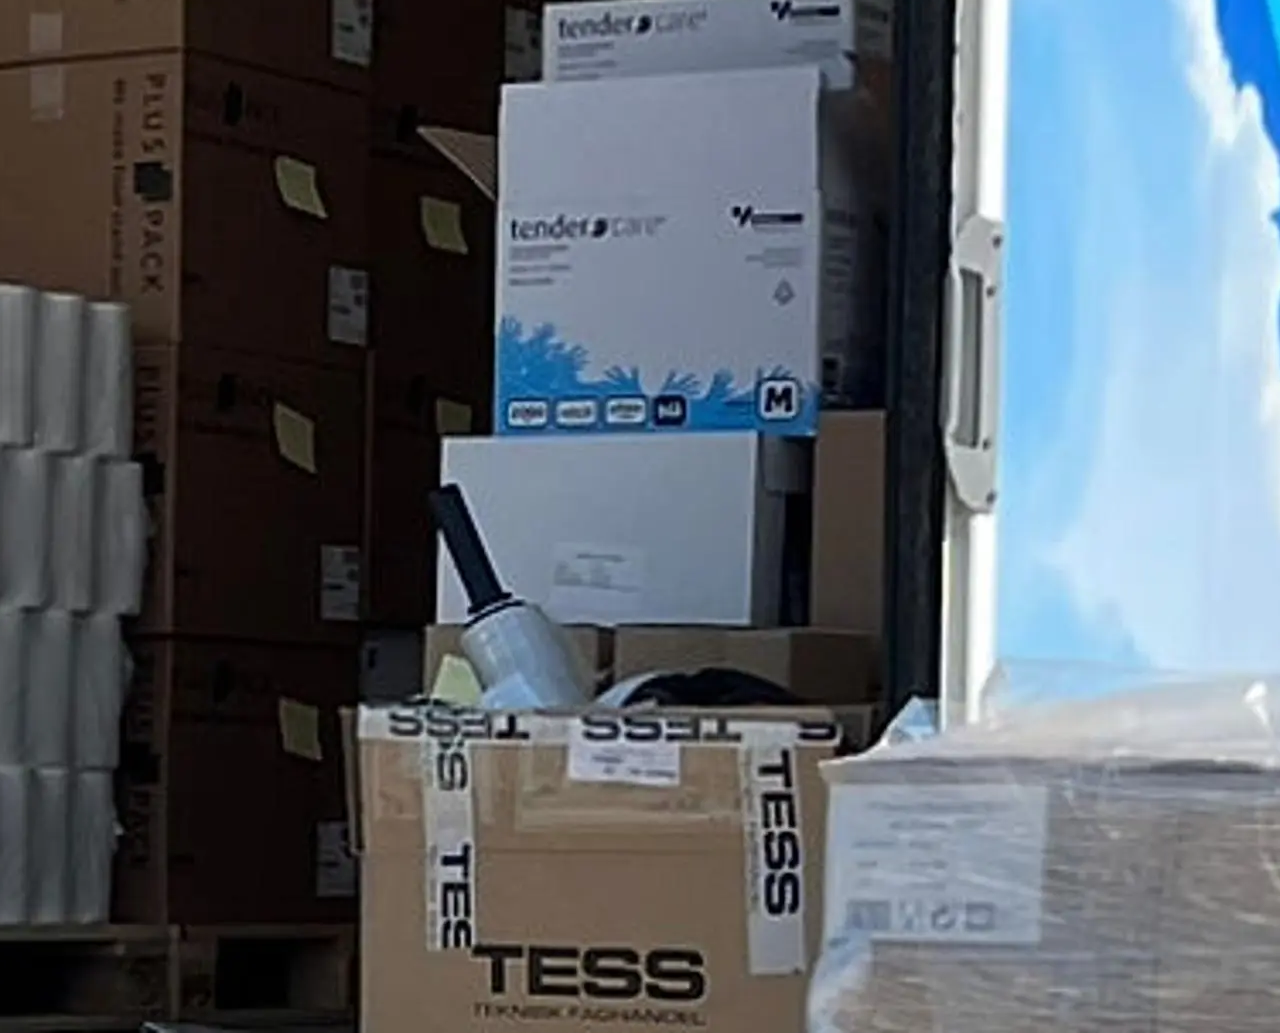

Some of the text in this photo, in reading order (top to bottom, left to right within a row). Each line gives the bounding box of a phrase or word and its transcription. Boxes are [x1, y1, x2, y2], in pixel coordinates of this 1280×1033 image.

[558, 11, 632, 39] tender
[140, 74, 163, 293] PLUS PACK
[511, 216, 588, 240] tender
[765, 386, 795, 415] M
[759, 750, 800, 914] TESS
[472, 945, 706, 1000] TESS
